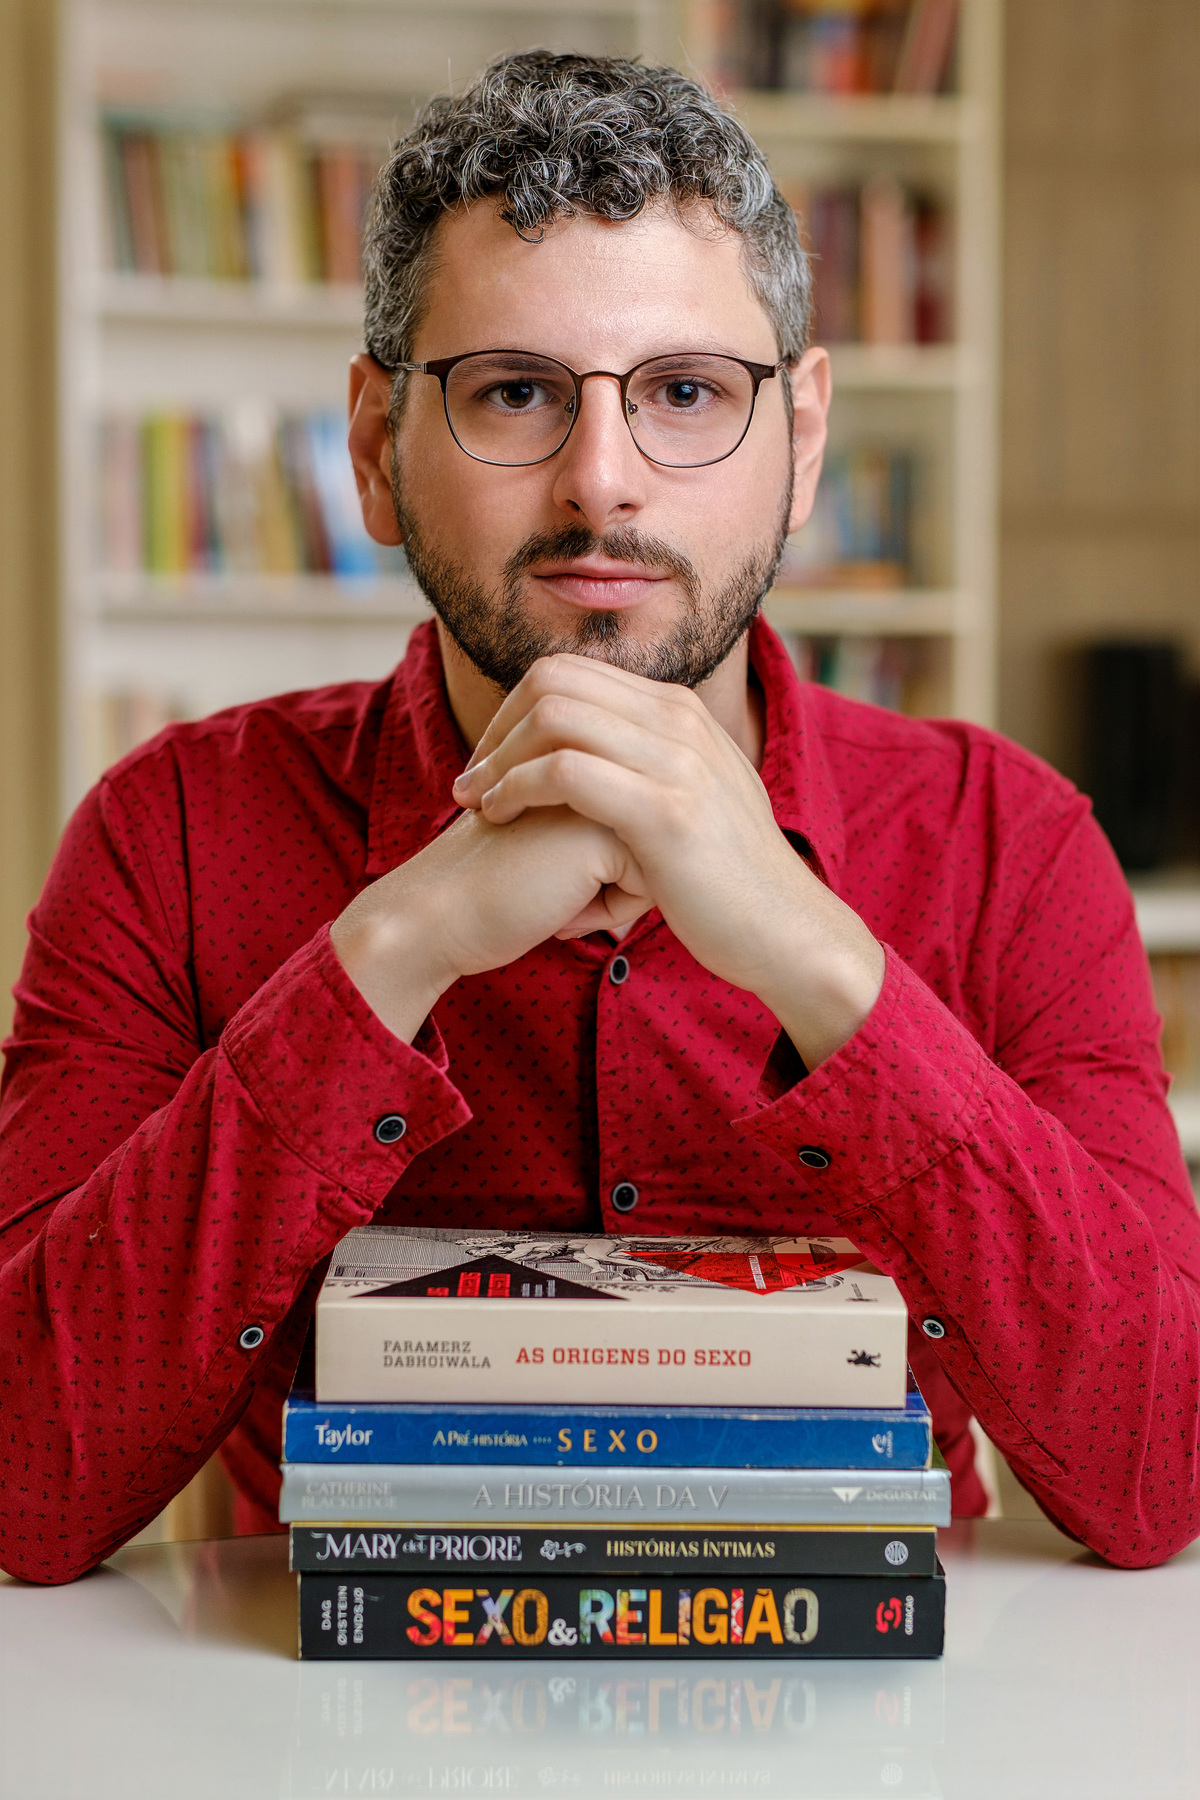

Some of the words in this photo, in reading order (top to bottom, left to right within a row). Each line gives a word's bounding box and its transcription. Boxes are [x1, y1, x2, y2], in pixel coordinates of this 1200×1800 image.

[383, 1340, 471, 1354] FARAMERZ
[516, 1348, 544, 1364] AS
[553, 1348, 650, 1365] ORIGENS
[657, 1349, 686, 1365] DO
[694, 1350, 752, 1366] SEXO
[383, 1355, 492, 1368] DABHOIWALA
[315, 1424, 373, 1452] Taylor
[432, 1430, 447, 1447] A
[557, 1428, 658, 1453] SEXO
[306, 1481, 392, 1496] CATHERINE
[473, 1484, 494, 1509] A
[504, 1478, 646, 1510] HISTÓRIA
[656, 1485, 698, 1510] DA
[708, 1485, 729, 1510] V
[310, 1531, 402, 1560] MARY
[414, 1533, 523, 1561] PRIORE
[606, 1538, 699, 1558] HISTÓRIAS
[703, 1538, 776, 1558] ÍNTIMAS
[321, 1600, 332, 1630] DAG
[337, 1585, 348, 1646] ØISTEIN
[353, 1587, 364, 1643] ENDSJØ
[406, 1588, 549, 1646] SEXO
[547, 1618, 578, 1646] &
[579, 1587, 819, 1645] RELIGIÃO
